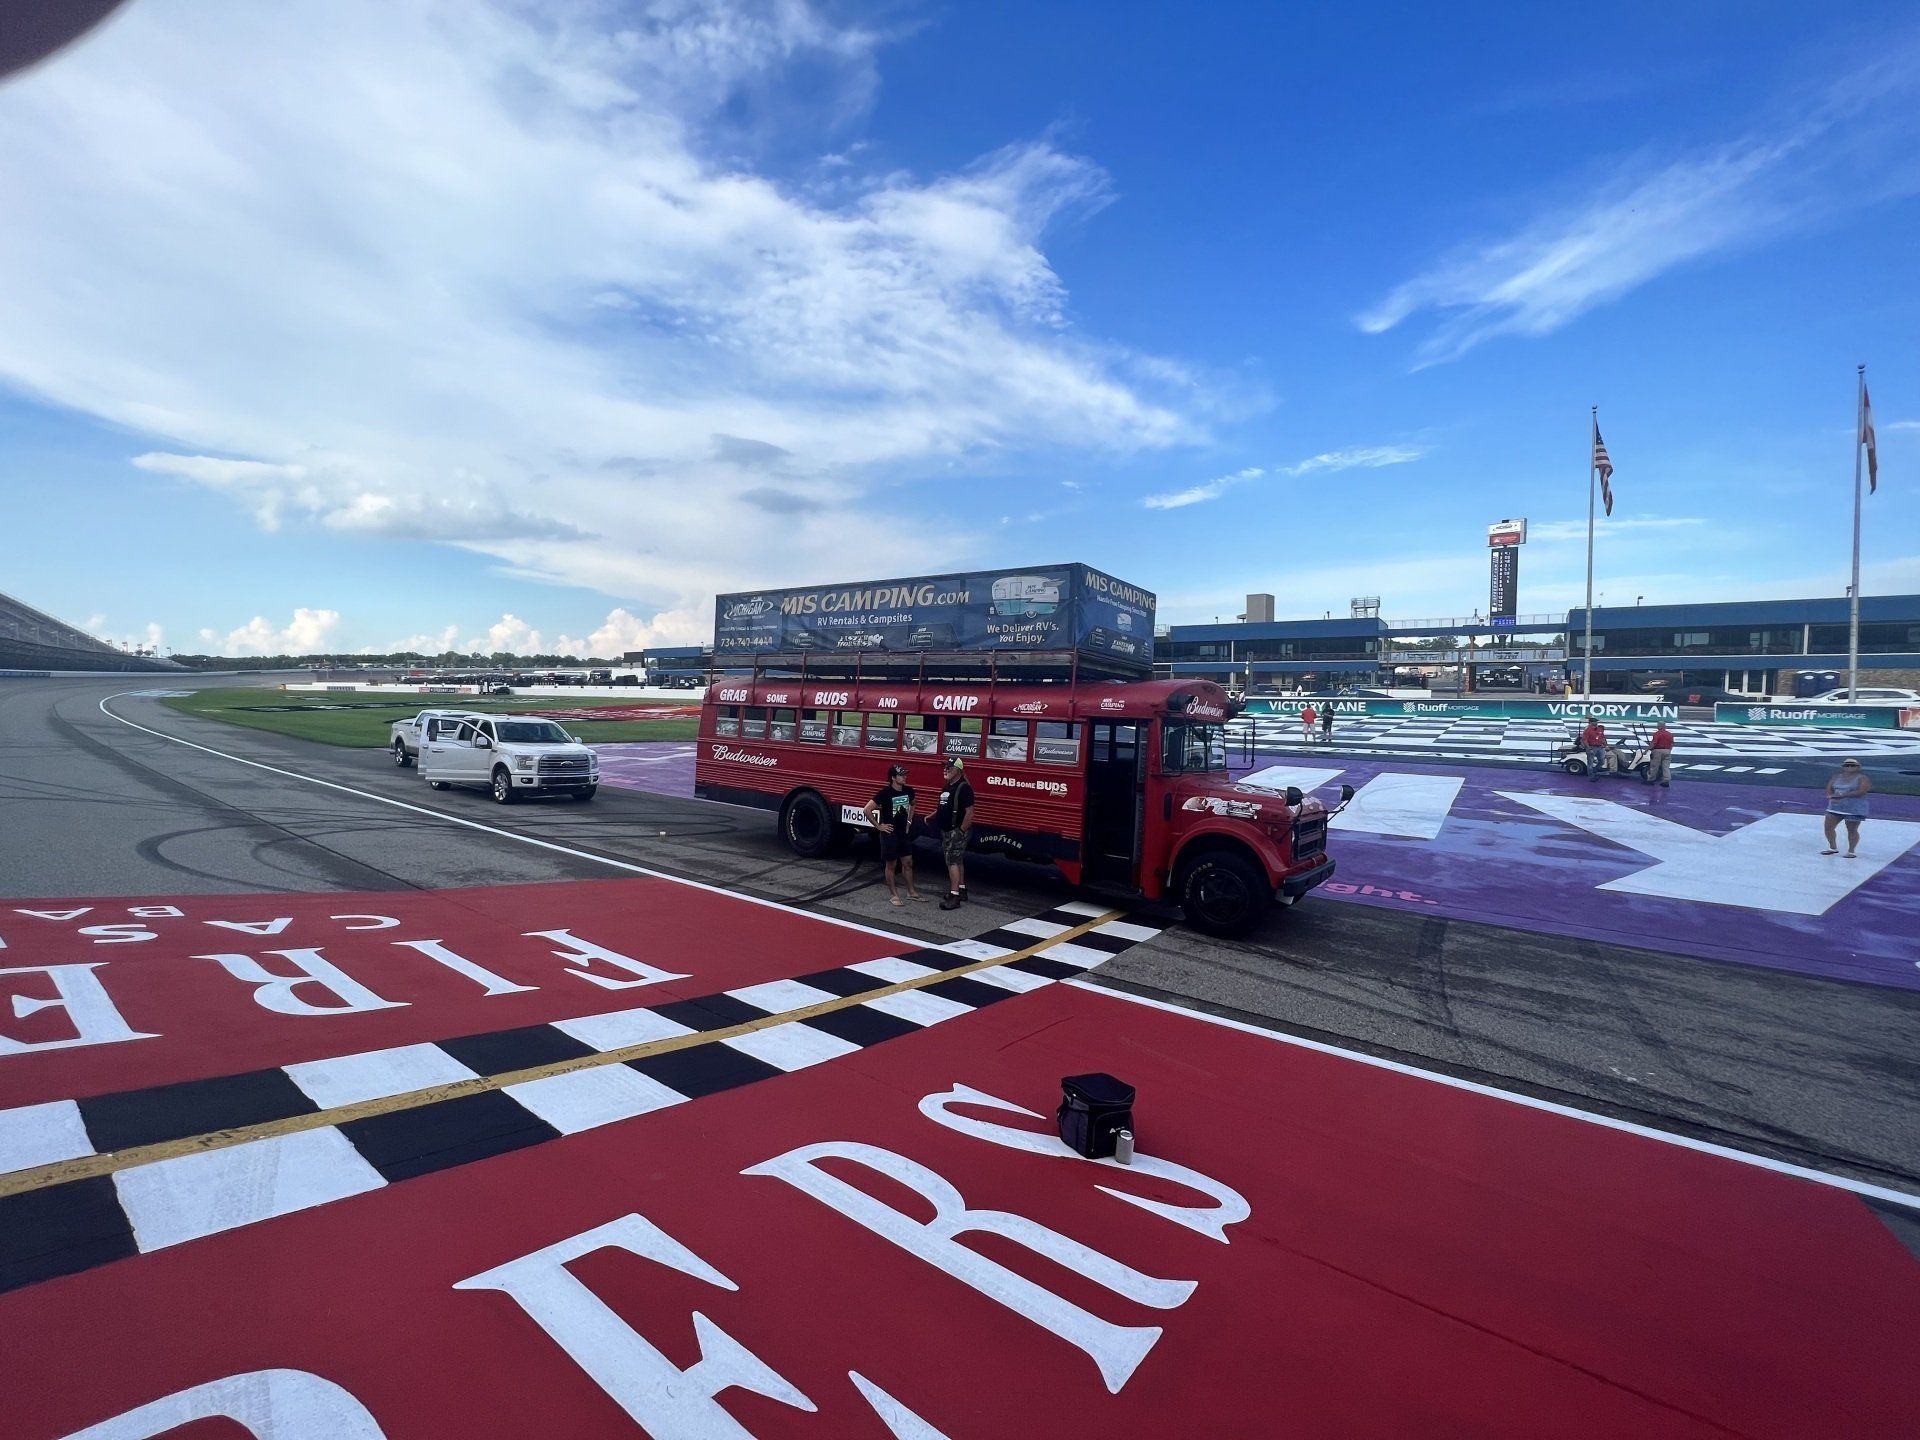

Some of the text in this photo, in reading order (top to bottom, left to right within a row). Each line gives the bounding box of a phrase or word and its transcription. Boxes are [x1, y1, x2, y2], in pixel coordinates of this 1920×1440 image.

[1085, 571, 1156, 611] MIS CAMPING
[779, 594, 818, 616] MIS
[817, 611, 913, 627] RV Rentals & Campsites
[986, 624, 1001, 634] We
[1002, 622, 1035, 633] Deliver
[999, 632, 1045, 644] You Enjoy.
[719, 688, 979, 712] GRAB SOME BUDS AND CAMP
[1185, 695, 1225, 718] Budweiser
[1268, 700, 1367, 713] VICTORY LANE
[1417, 702, 1449, 712] Ruoff
[1547, 702, 1679, 719] VICTORY LAN
[1770, 708, 1817, 721] Ruoff
[1817, 711, 1867, 721] MORTGAGE
[945, 744, 978, 754] CAMPING
[948, 738, 963, 746] MIS
[711, 744, 778, 767] Budweiser
[986, 775, 1068, 793] GRAB SOME BUDS
[980, 834, 1023, 850] GOODYEAR
[1322, 883, 1439, 905] ght.
